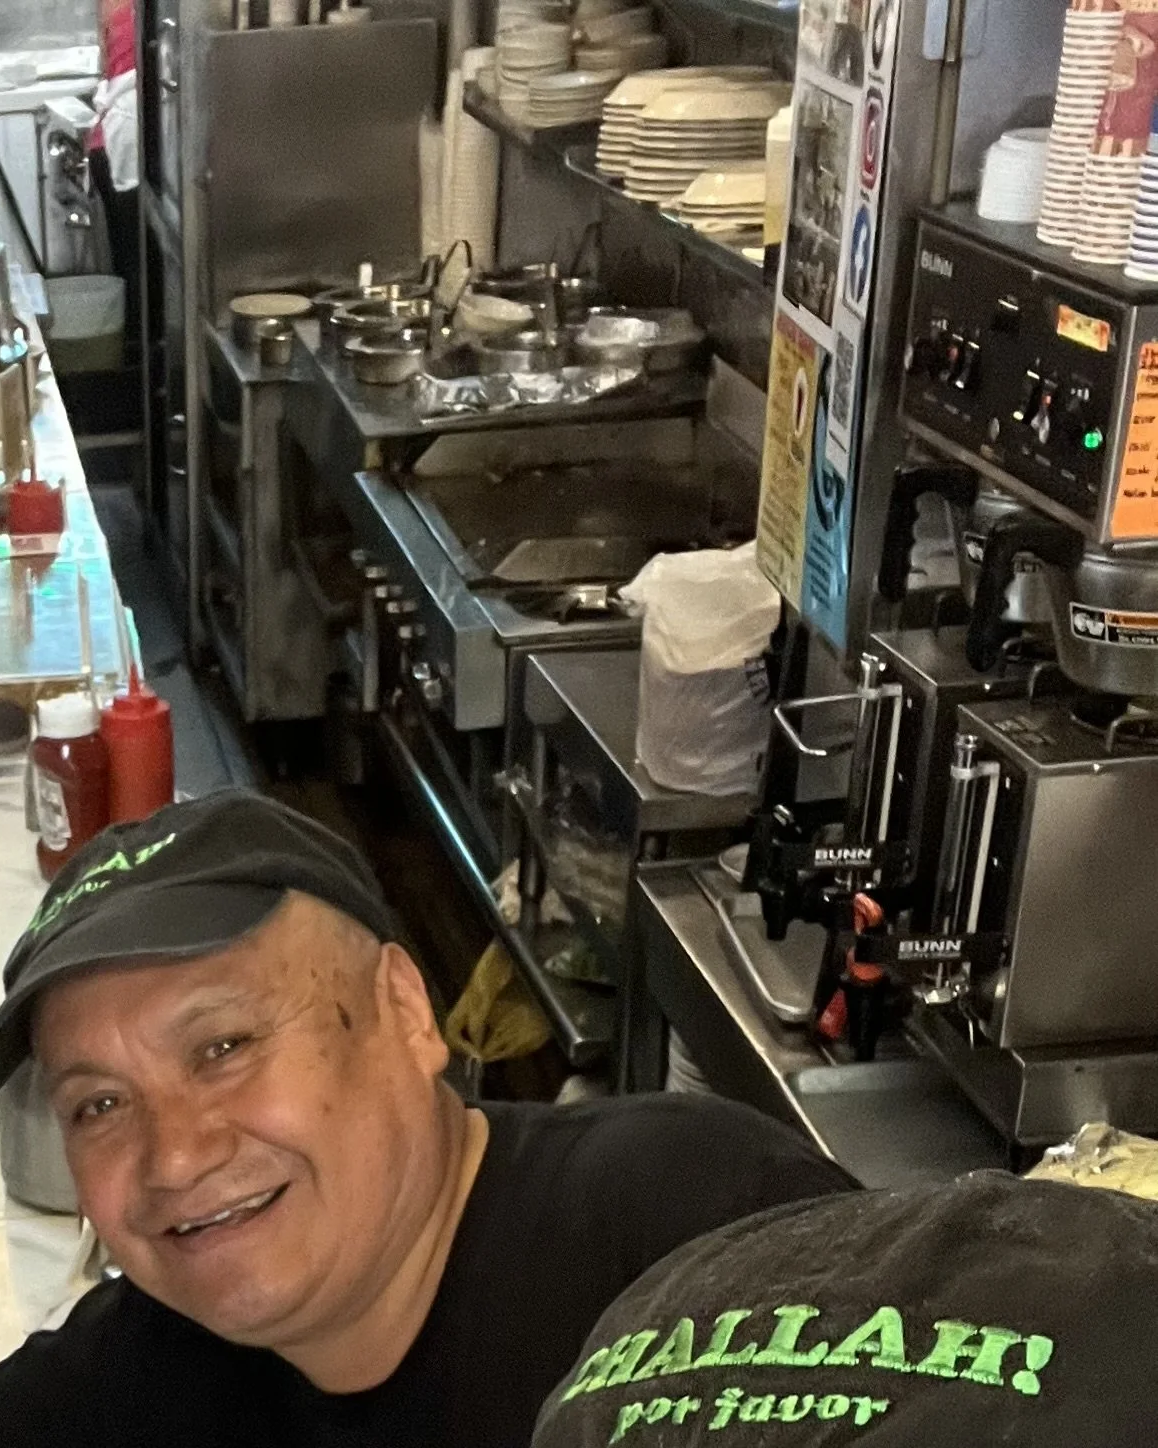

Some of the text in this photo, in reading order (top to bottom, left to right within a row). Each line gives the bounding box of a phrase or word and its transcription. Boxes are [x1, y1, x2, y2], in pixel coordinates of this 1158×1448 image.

[921, 250, 954, 279] BUNN
[814, 847, 873, 860] BUNN
[898, 939, 962, 952] BUNN
[608, 1387, 891, 1445] por favor
